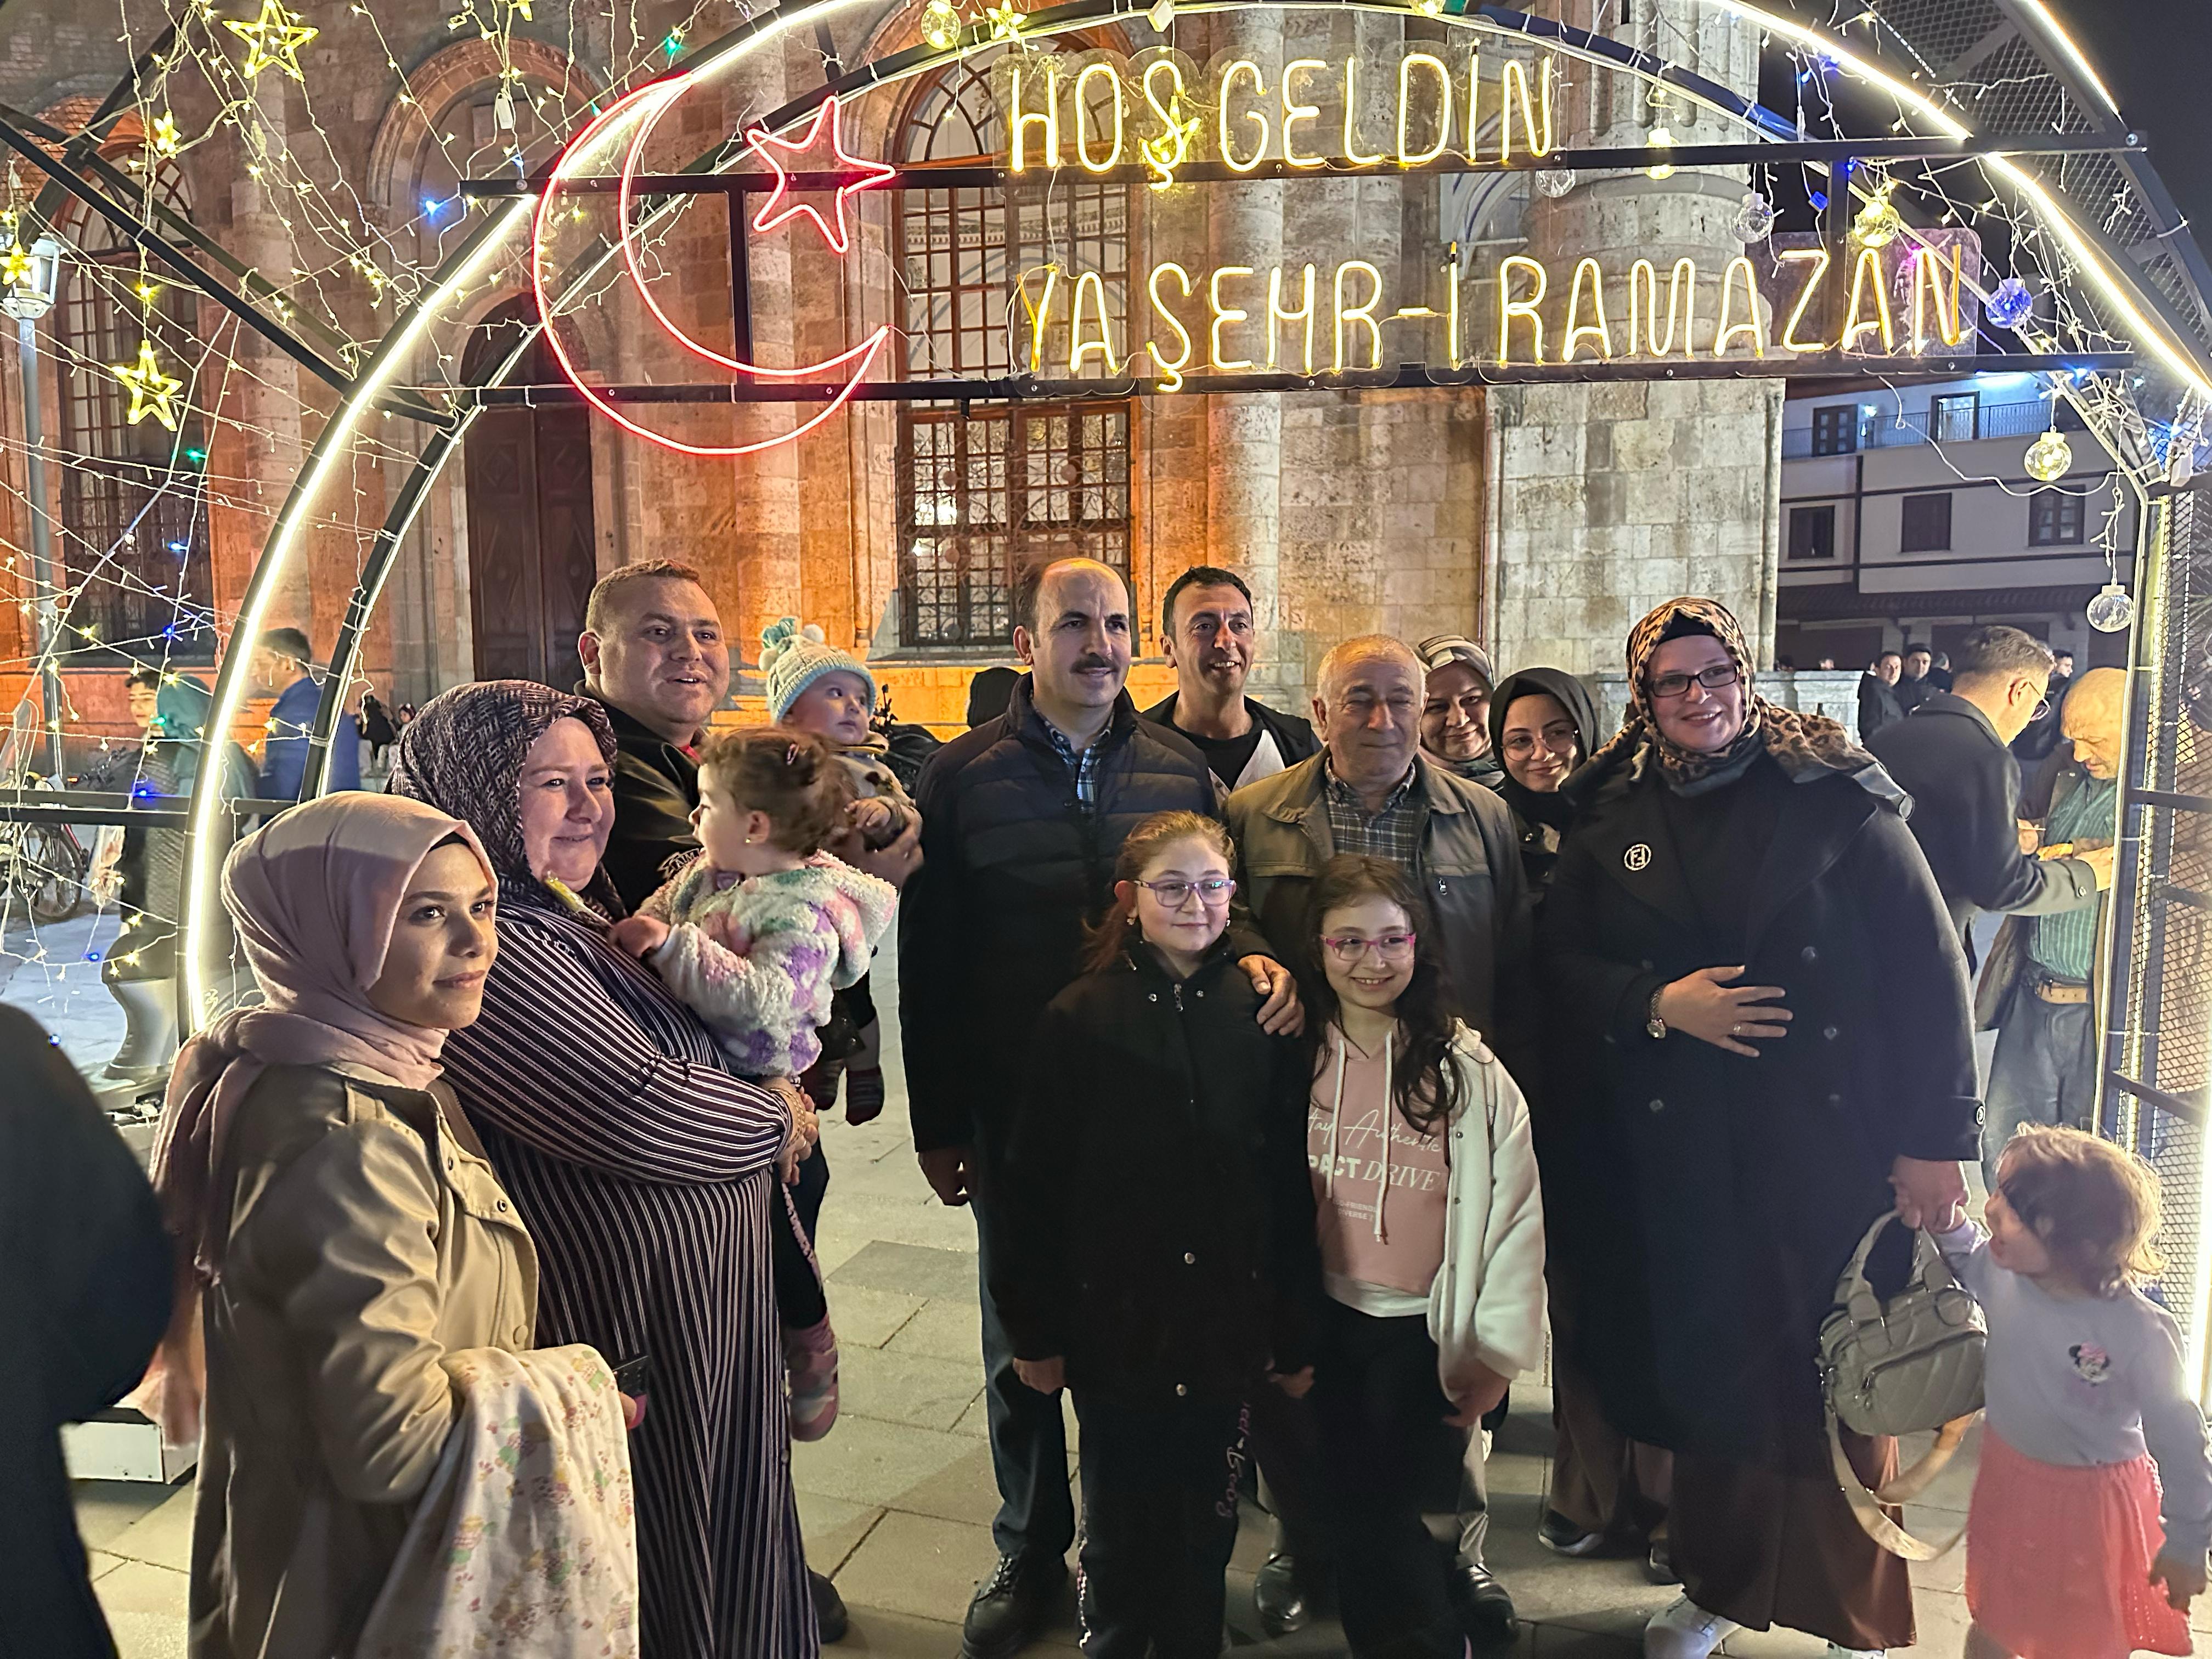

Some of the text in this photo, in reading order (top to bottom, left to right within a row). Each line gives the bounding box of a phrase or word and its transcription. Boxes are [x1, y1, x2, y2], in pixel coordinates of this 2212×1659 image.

[1016, 263, 1120, 374] YA
[1499, 244, 1961, 368] RAMAZAN
[1308, 1107, 1334, 1145] tay
[1308, 1153, 1441, 1190] PACT DRIVE
